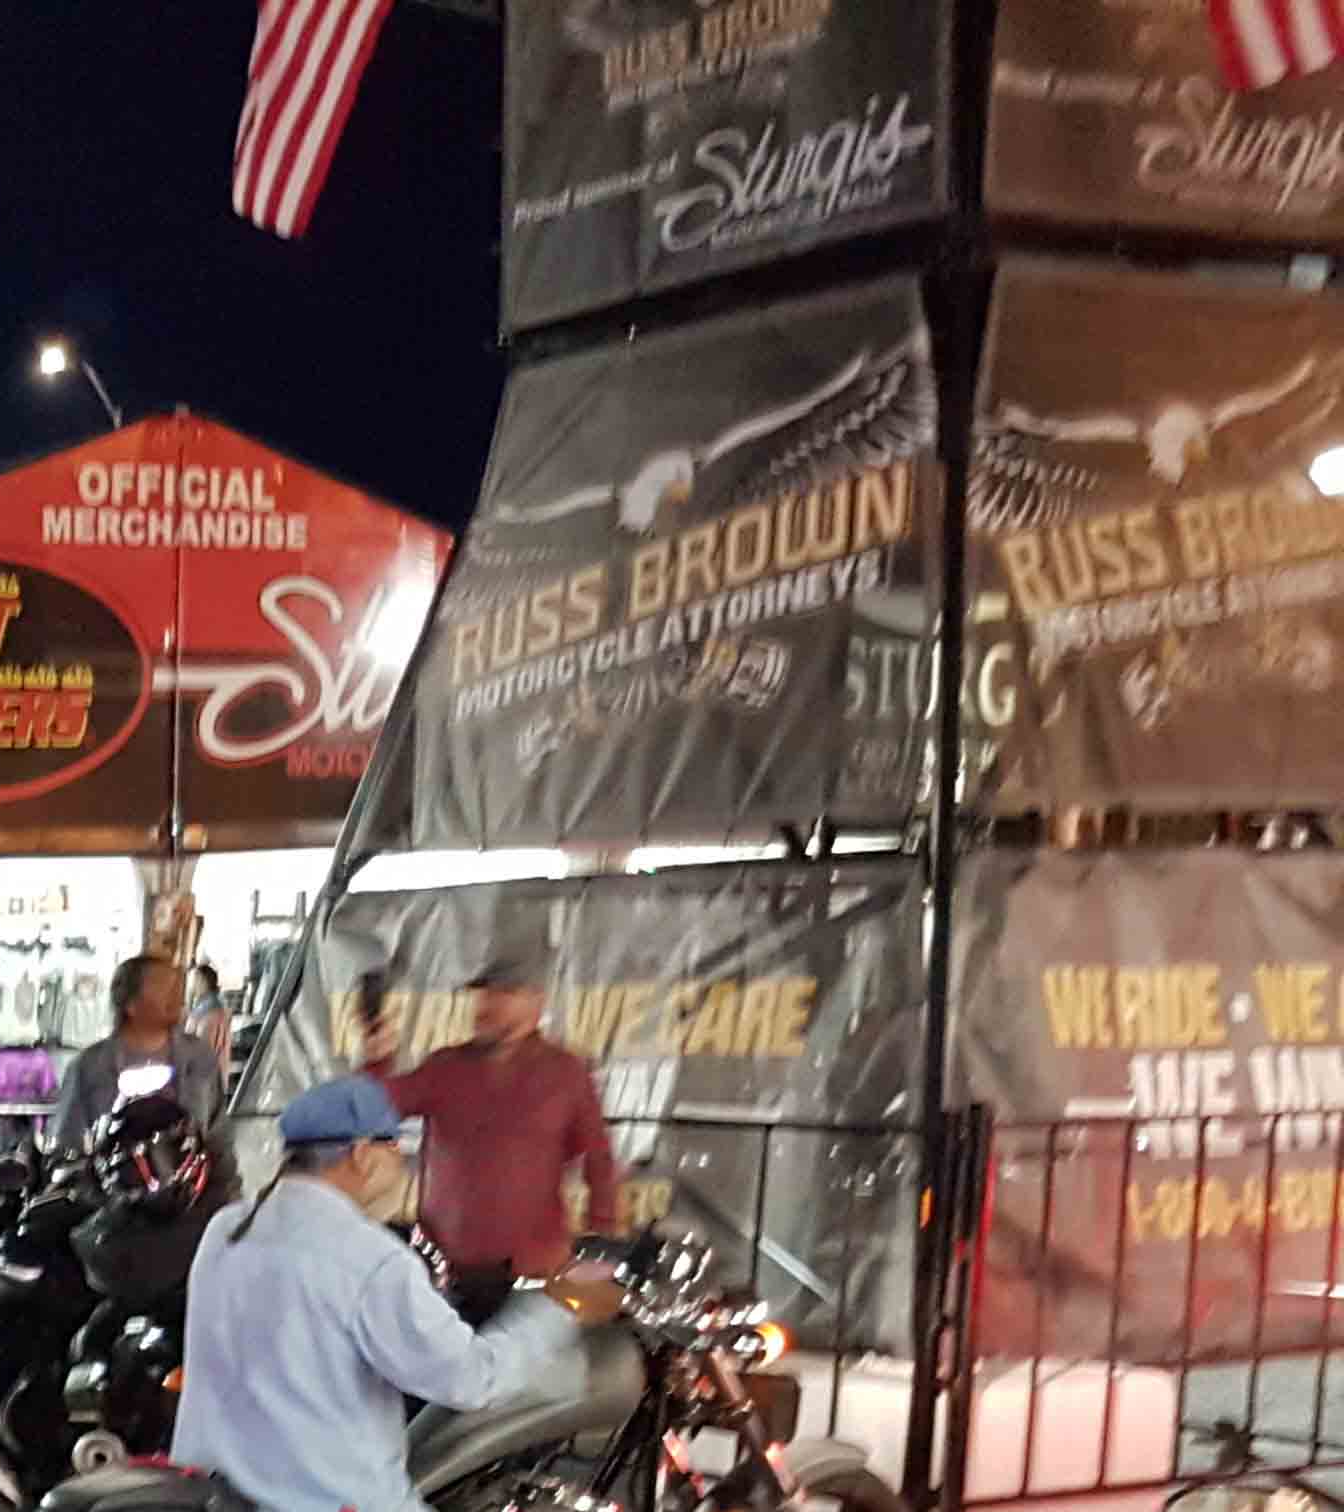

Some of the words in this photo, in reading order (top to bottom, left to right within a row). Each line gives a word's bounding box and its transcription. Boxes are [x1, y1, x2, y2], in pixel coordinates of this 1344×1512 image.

[654, 92, 934, 252] Sturgis
[41, 504, 308, 550] MERCHANDISE
[78, 462, 276, 512] OFFICIAL
[449, 562, 608, 688] RUSS
[628, 462, 913, 616] BROWN
[1001, 508, 1171, 624] RUSS
[454, 601, 655, 720] MOTORCYCLE
[656, 976, 817, 1057] CARE
[1115, 960, 1232, 1047] RIDE
[1252, 960, 1333, 1043] WE
